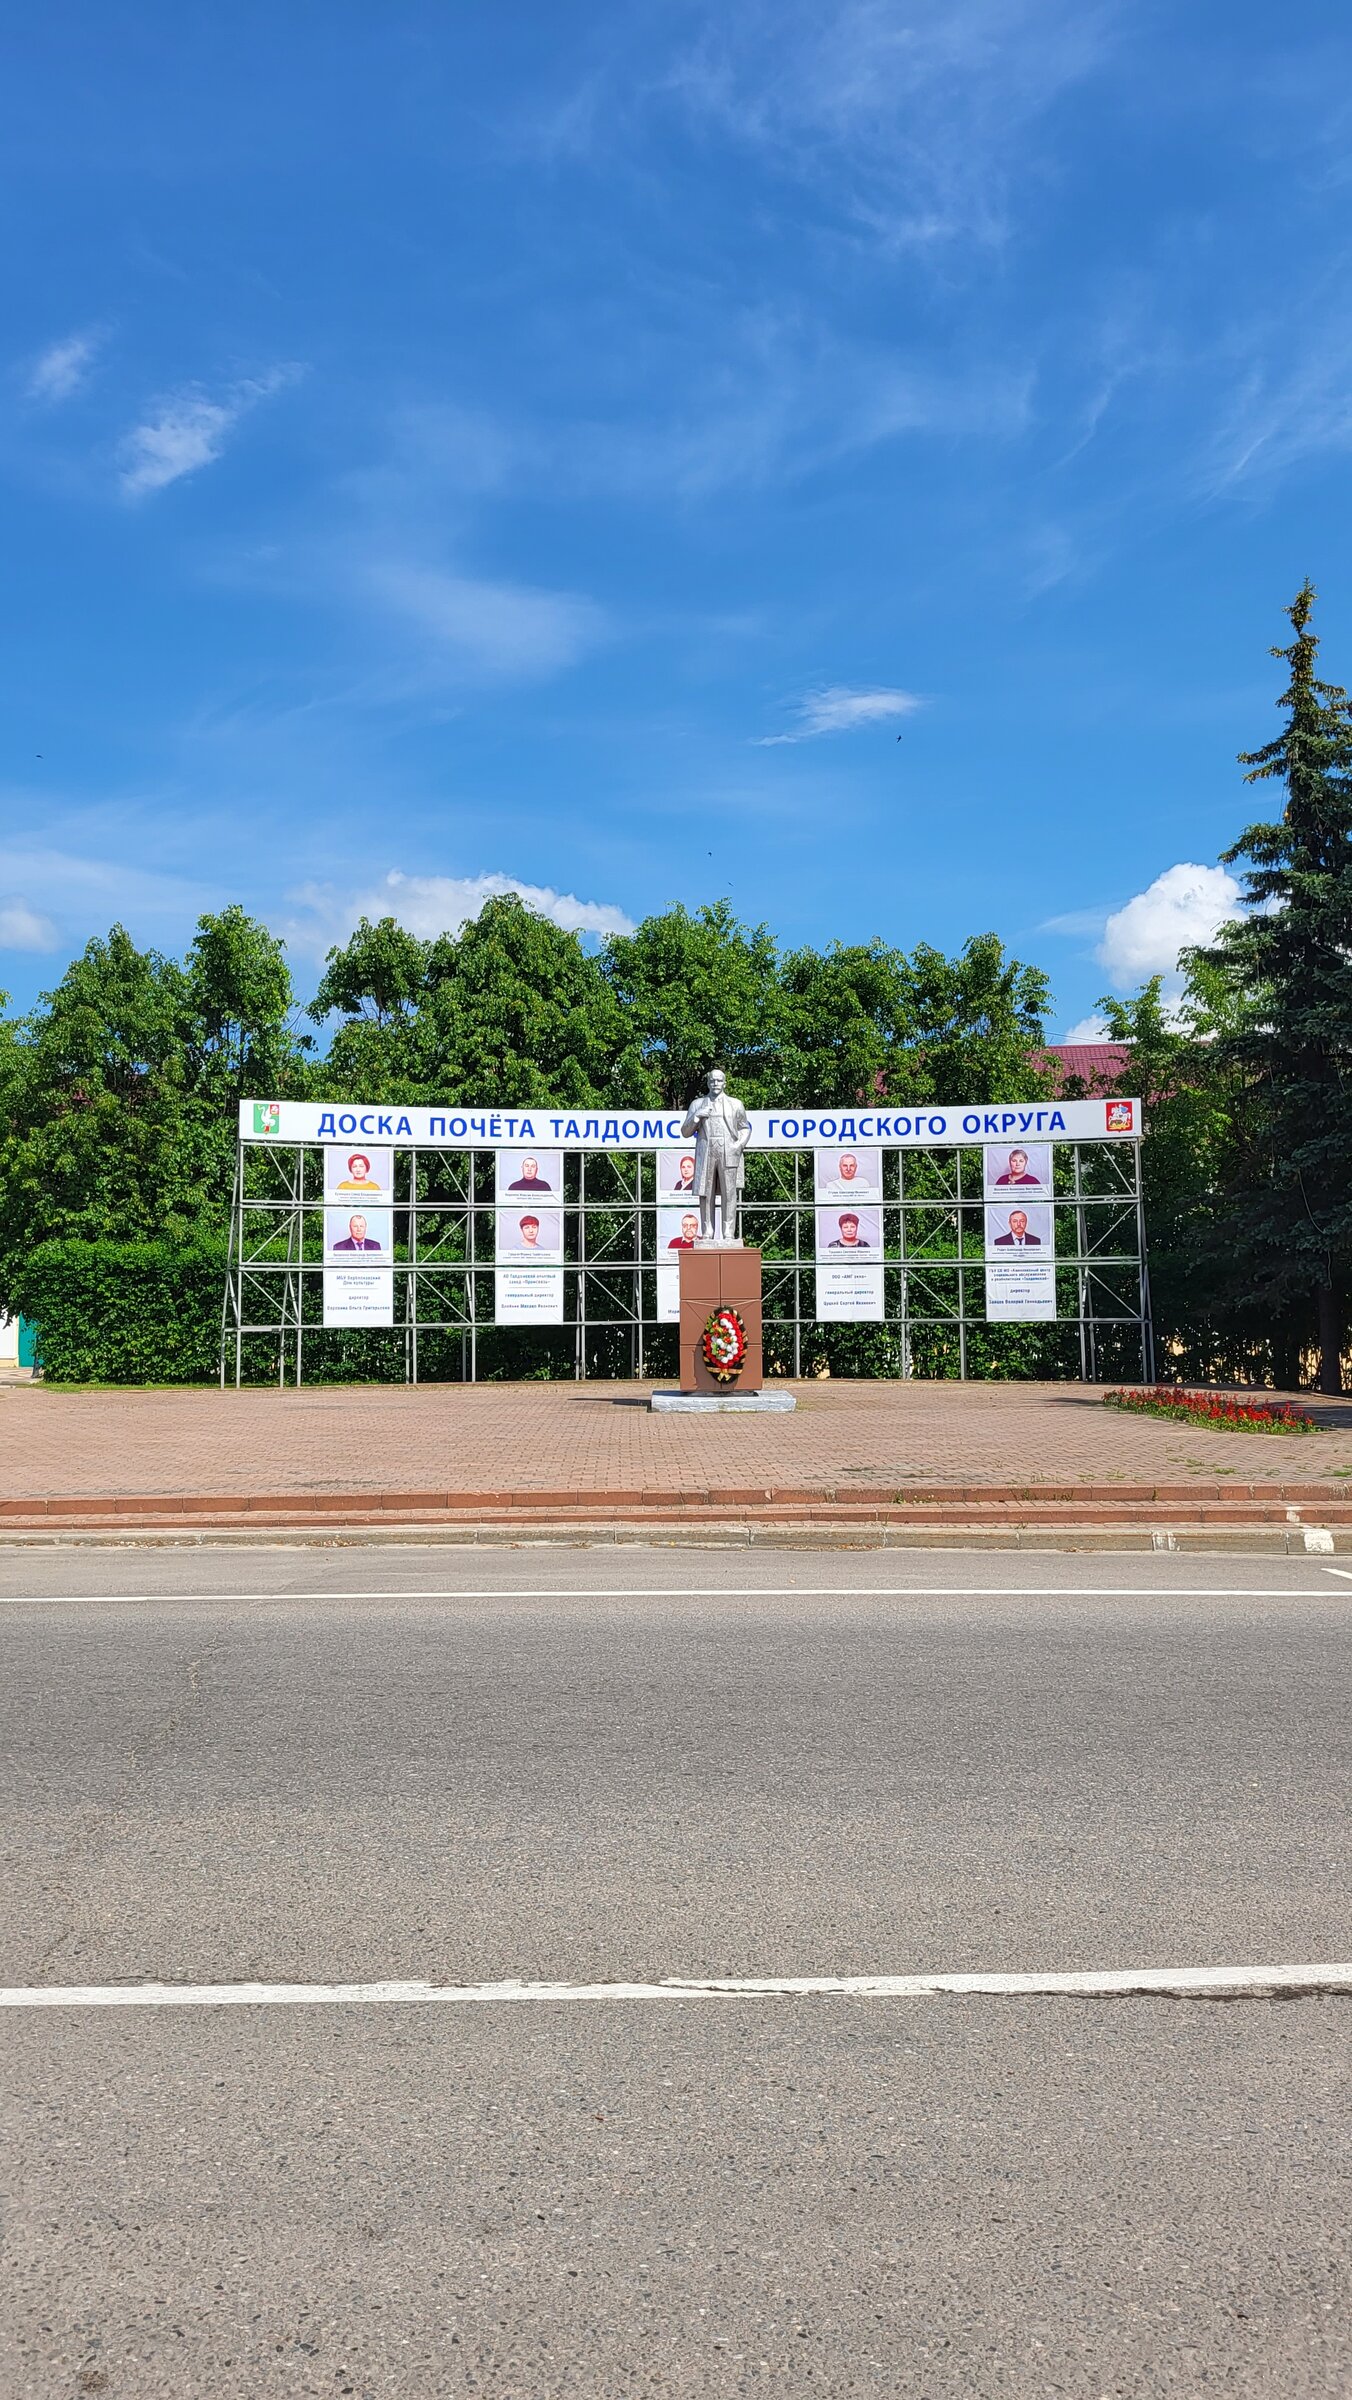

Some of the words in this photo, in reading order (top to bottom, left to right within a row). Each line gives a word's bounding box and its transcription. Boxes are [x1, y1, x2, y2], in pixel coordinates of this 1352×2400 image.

[317, 1113, 413, 1138] ДОСКА
[429, 1114, 536, 1138] ПОЧЁТА
[550, 1119, 752, 1143] ТАЛДОМС
[768, 1114, 947, 1142] ГОРОДСКОГО
[962, 1111, 1066, 1134] ОКРУГА
